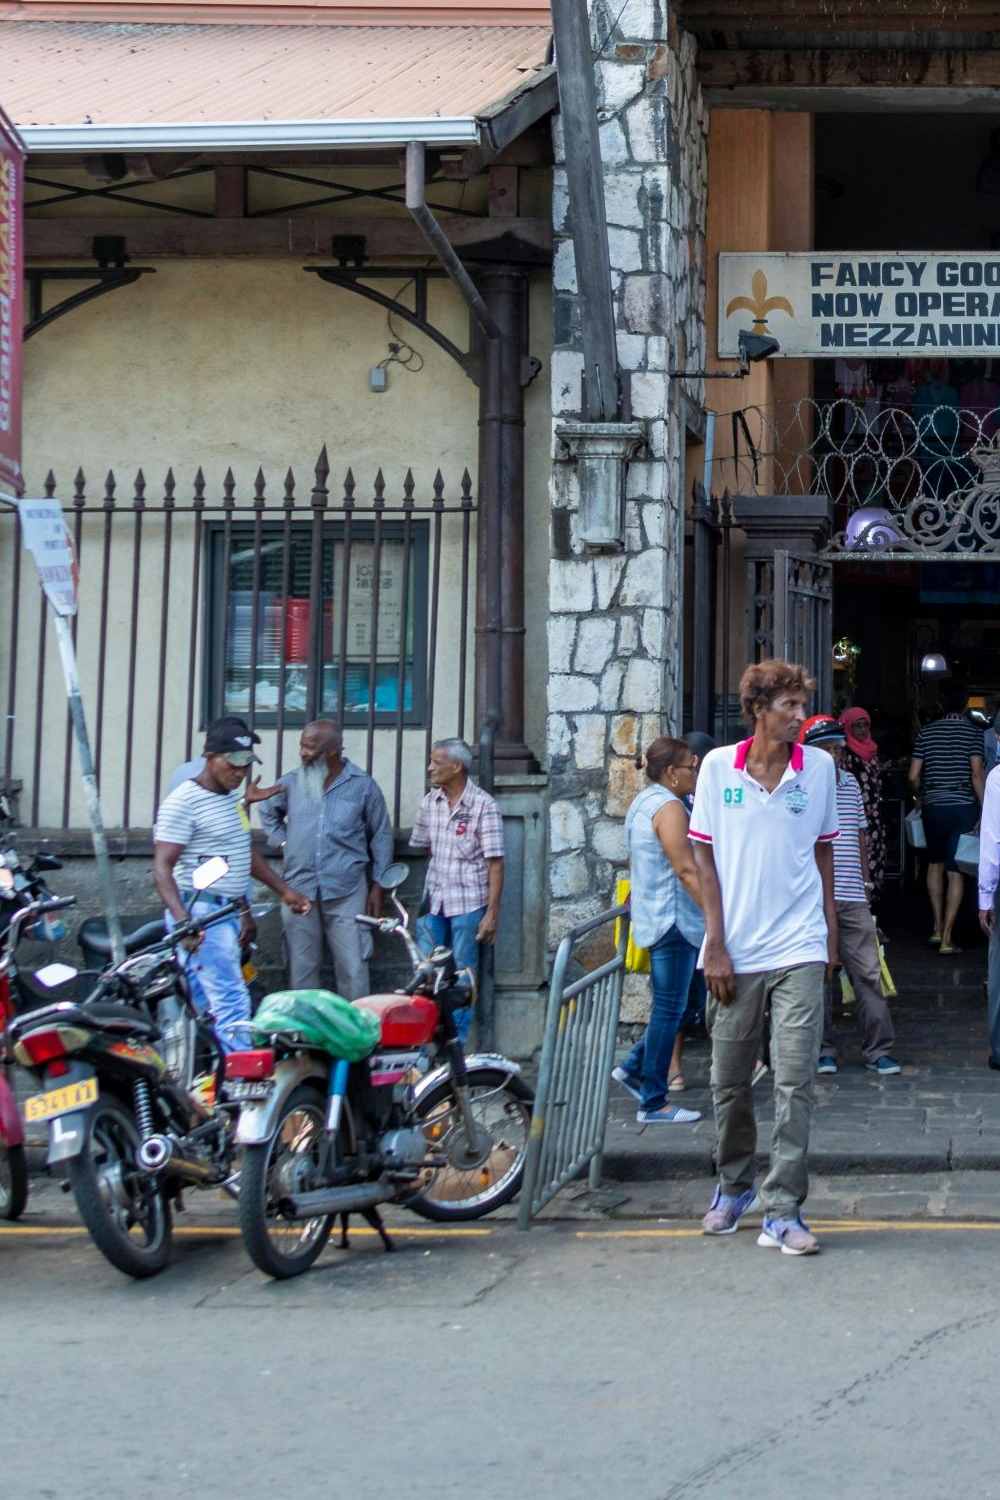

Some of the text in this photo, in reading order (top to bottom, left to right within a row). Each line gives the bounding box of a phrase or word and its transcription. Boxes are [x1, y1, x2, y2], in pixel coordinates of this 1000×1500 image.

[811, 262, 927, 286] FANCY
[811, 292, 883, 318] NOW
[723, 787, 743, 803] 03
